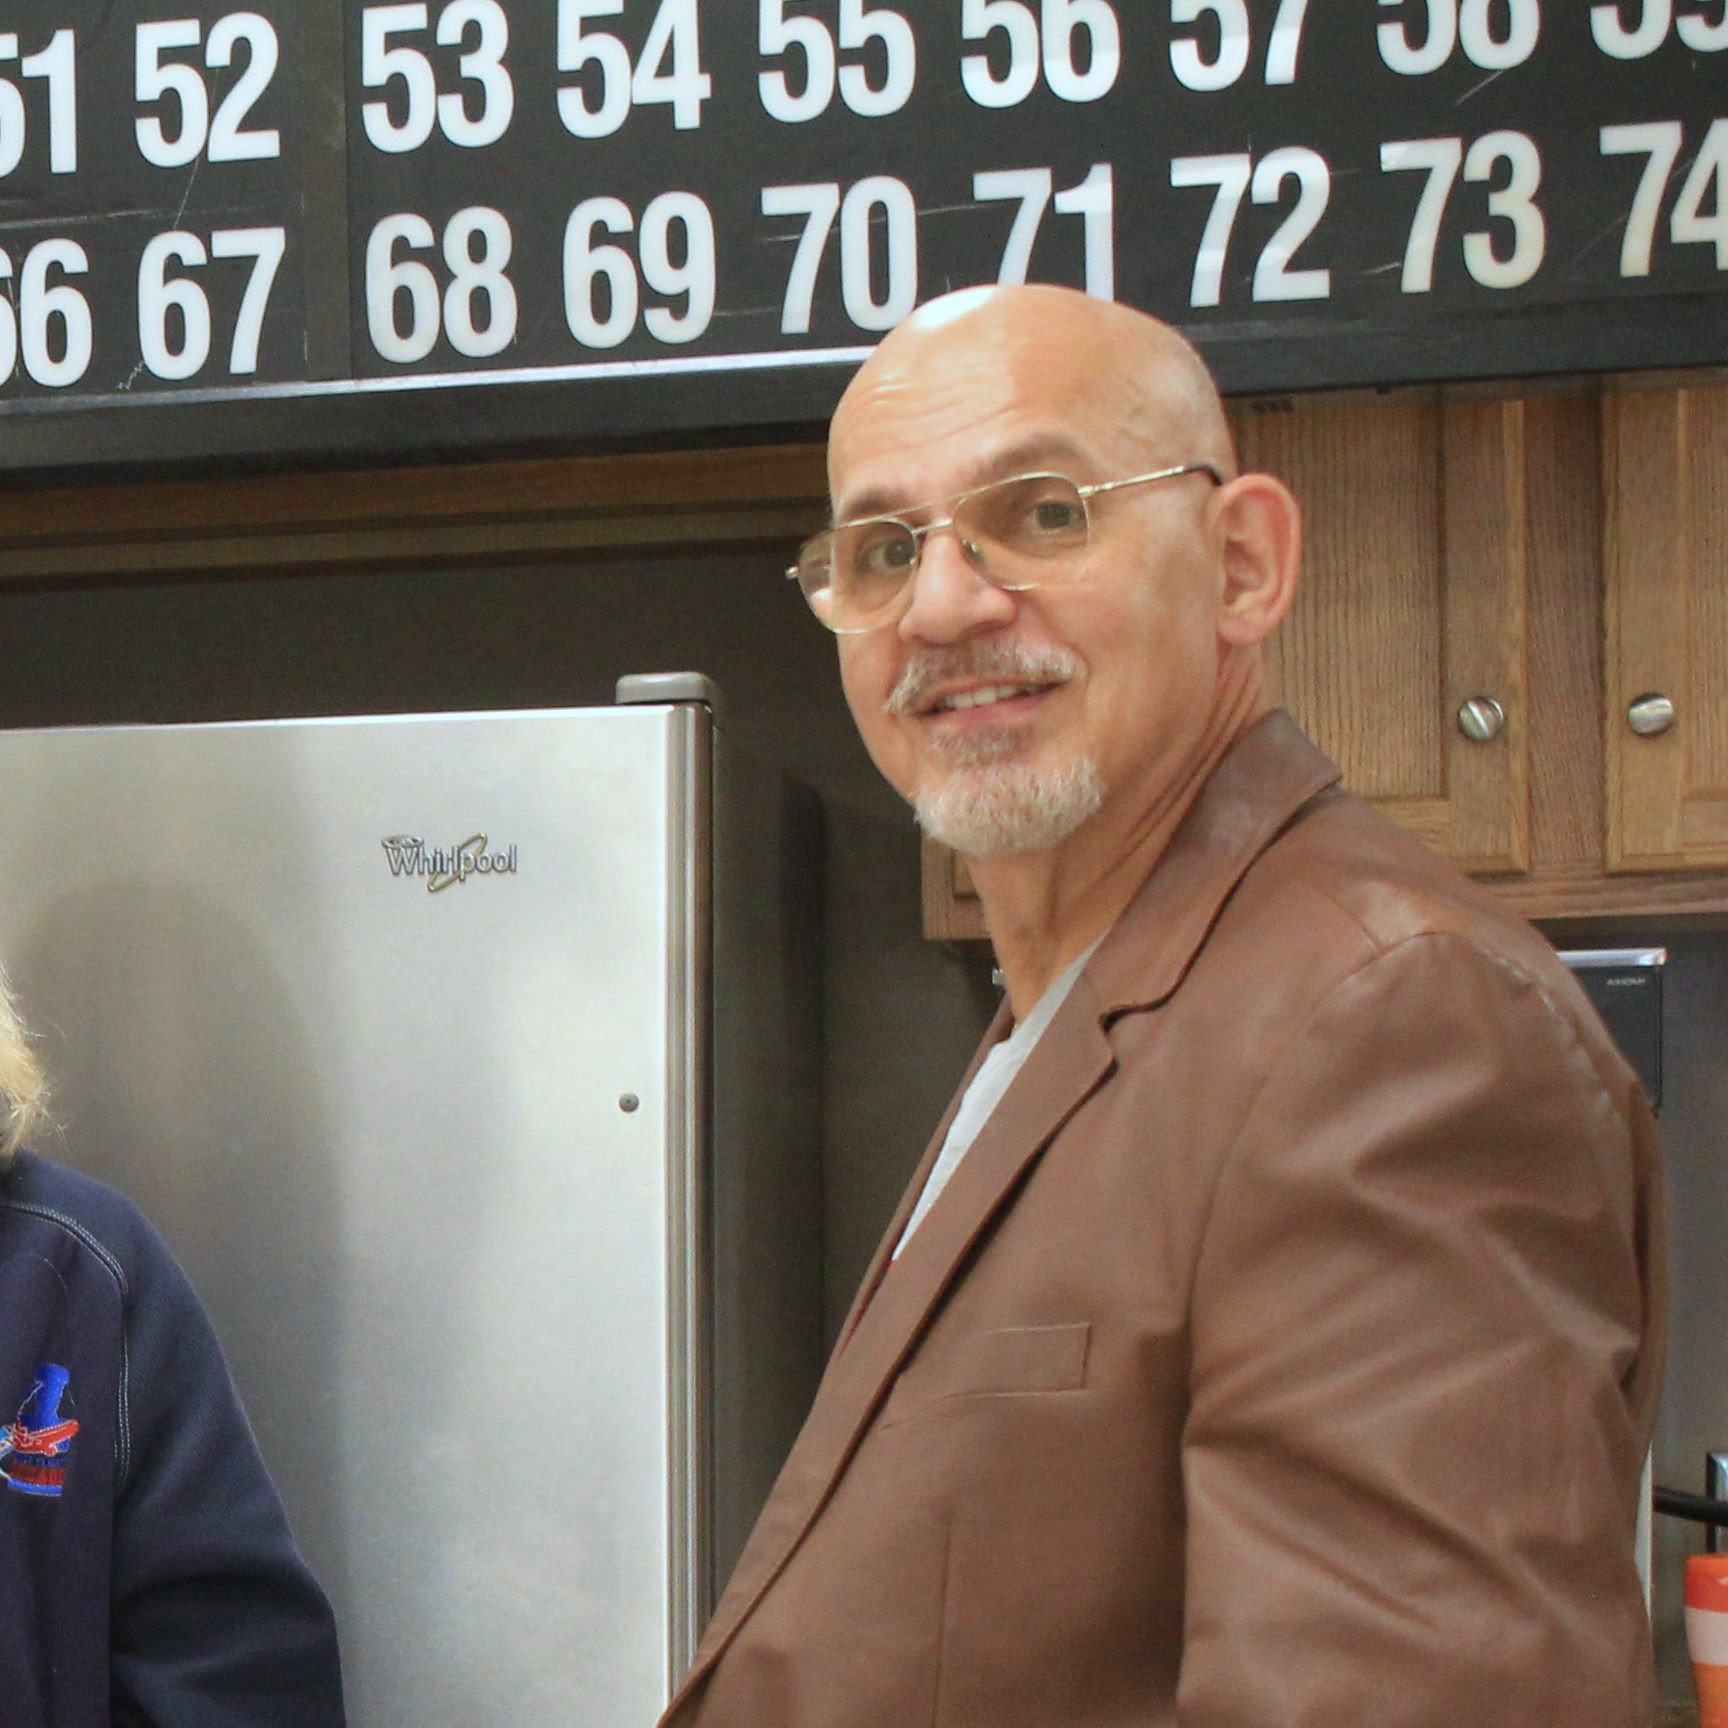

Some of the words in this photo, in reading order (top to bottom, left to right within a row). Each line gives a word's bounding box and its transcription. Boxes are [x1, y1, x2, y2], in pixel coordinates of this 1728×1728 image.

[135, 11, 281, 168] 52
[362, 1, 515, 153] 53
[556, 0, 712, 139] 54
[758, 0, 916, 123] 55
[961, 0, 1121, 108] 56
[137, 226, 286, 380] 67
[365, 206, 518, 363] 68
[562, 191, 716, 349] 69
[761, 176, 918, 334] 70
[972, 163, 1115, 302] 71
[1170, 146, 1331, 308] 72
[1380, 130, 1545, 293] 73
[1600, 118, 1728, 277] 74
[382, 834, 518, 883] Whirlpool
